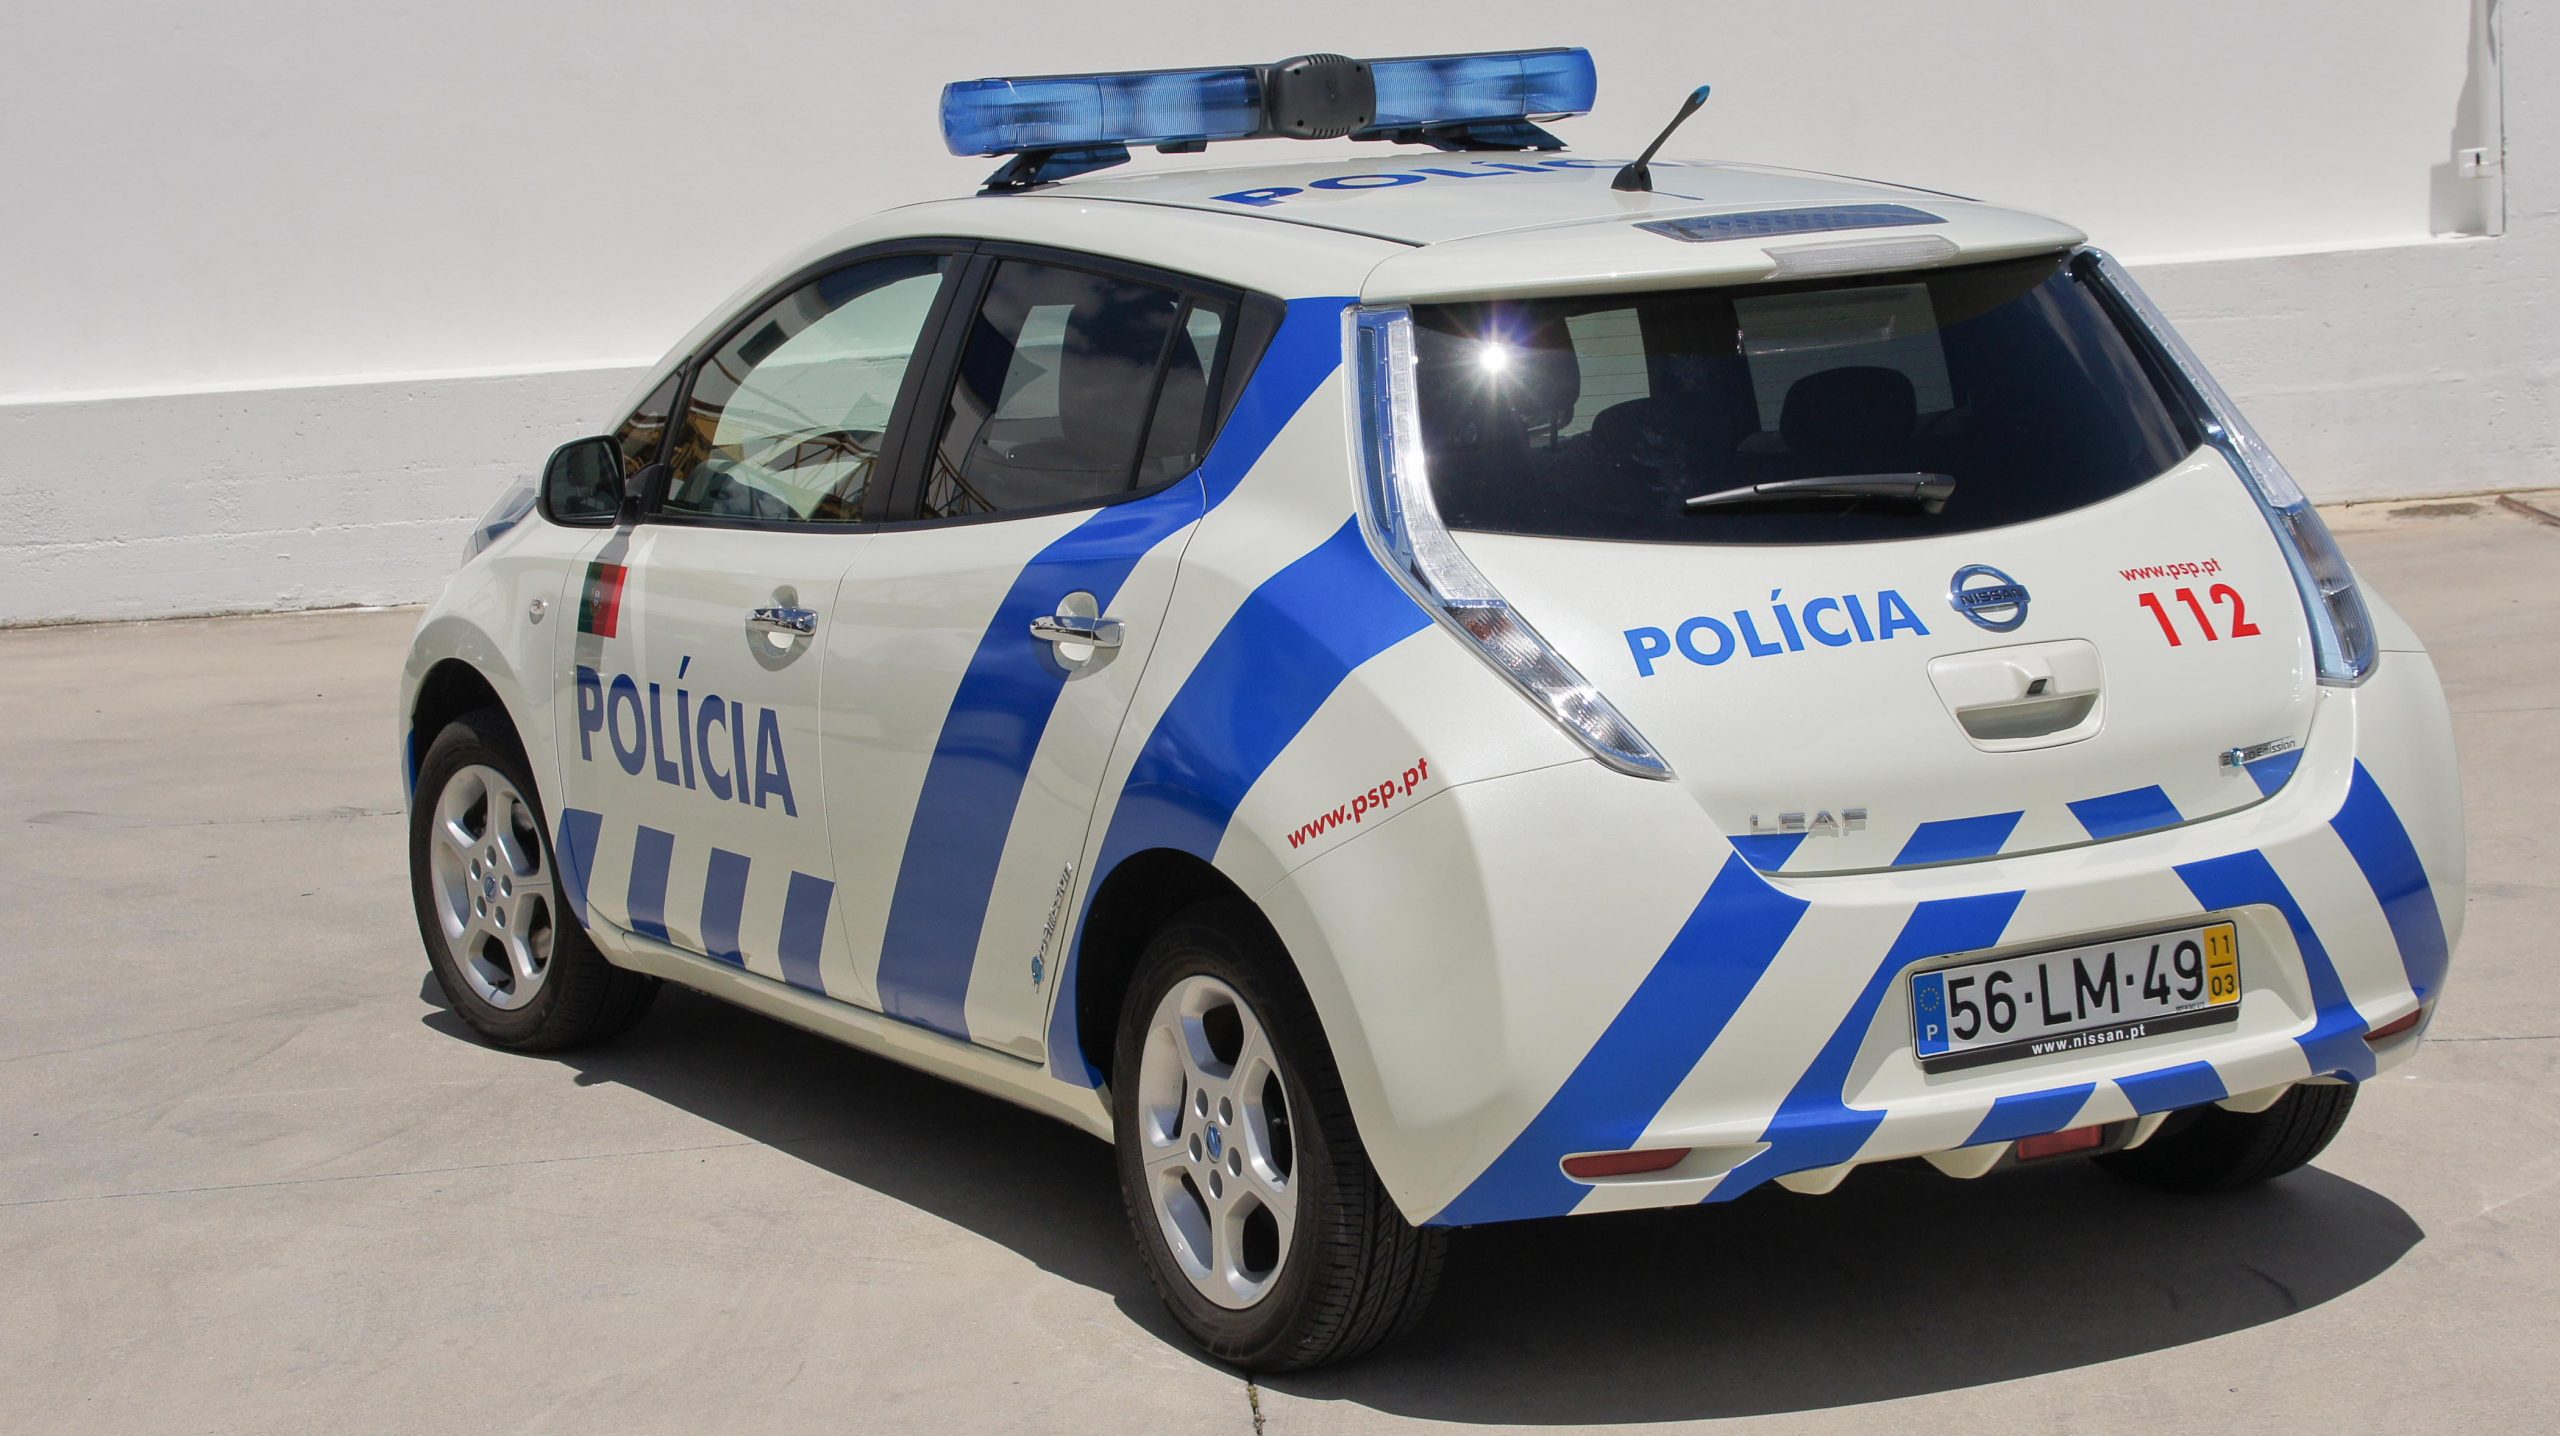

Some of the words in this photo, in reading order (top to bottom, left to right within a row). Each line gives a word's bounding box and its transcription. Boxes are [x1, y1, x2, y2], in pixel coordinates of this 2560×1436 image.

[2119, 557, 2222, 582] www.psp.pt
[1960, 588, 2025, 606] NISSAN
[2138, 583, 2261, 647] 112
[1623, 588, 1931, 678] POLÍCIA
[576, 655, 798, 818] POLÍCIA
[1287, 757, 1428, 849] www.psp.pt
[1749, 808, 1868, 834] LEAF
[2210, 934, 2231, 957] 11
[2211, 973, 2235, 997] 03
[1927, 1024, 1938, 1042] P
[2031, 1023, 2146, 1055] www.nissan.pt
